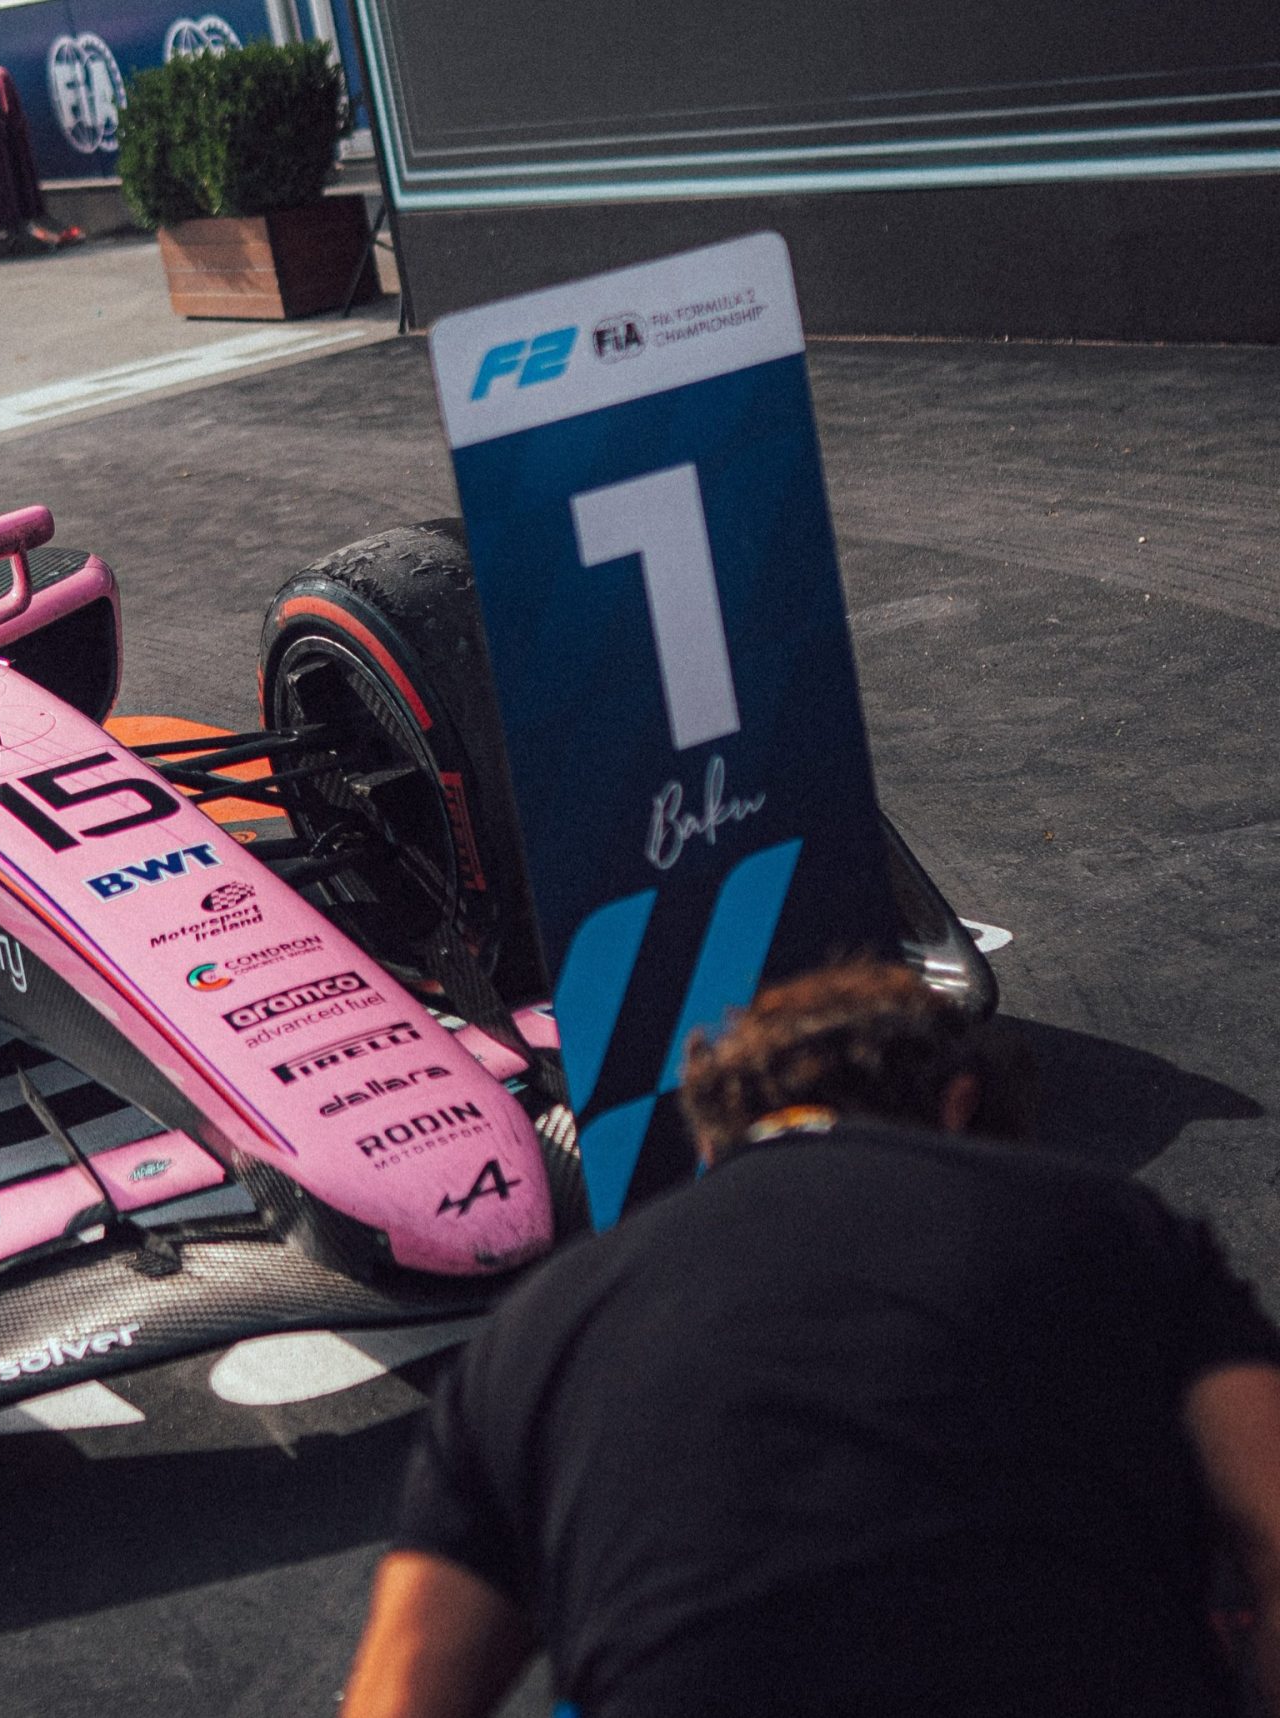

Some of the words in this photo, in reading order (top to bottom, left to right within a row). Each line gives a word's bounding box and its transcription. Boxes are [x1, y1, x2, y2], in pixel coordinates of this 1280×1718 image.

[653, 304, 768, 348] CHAMPIONSHIP
[677, 294, 744, 321] FORMULA
[746, 288, 757, 305] 2
[469, 325, 581, 402] F2
[570, 462, 740, 751] 1
[82, 841, 223, 902] BWT
[150, 904, 261, 948] Motorsport
[195, 912, 264, 943] Ireland
[224, 934, 322, 970] CONDRON
[231, 974, 361, 1028] aramco
[245, 1003, 345, 1049] advanced
[345, 991, 387, 1011] fuel
[271, 1021, 422, 1085] PIRELLI
[319, 1066, 453, 1117] dallara
[356, 1101, 484, 1158] RODIN
[374, 1122, 494, 1171] MOTORSPORT
